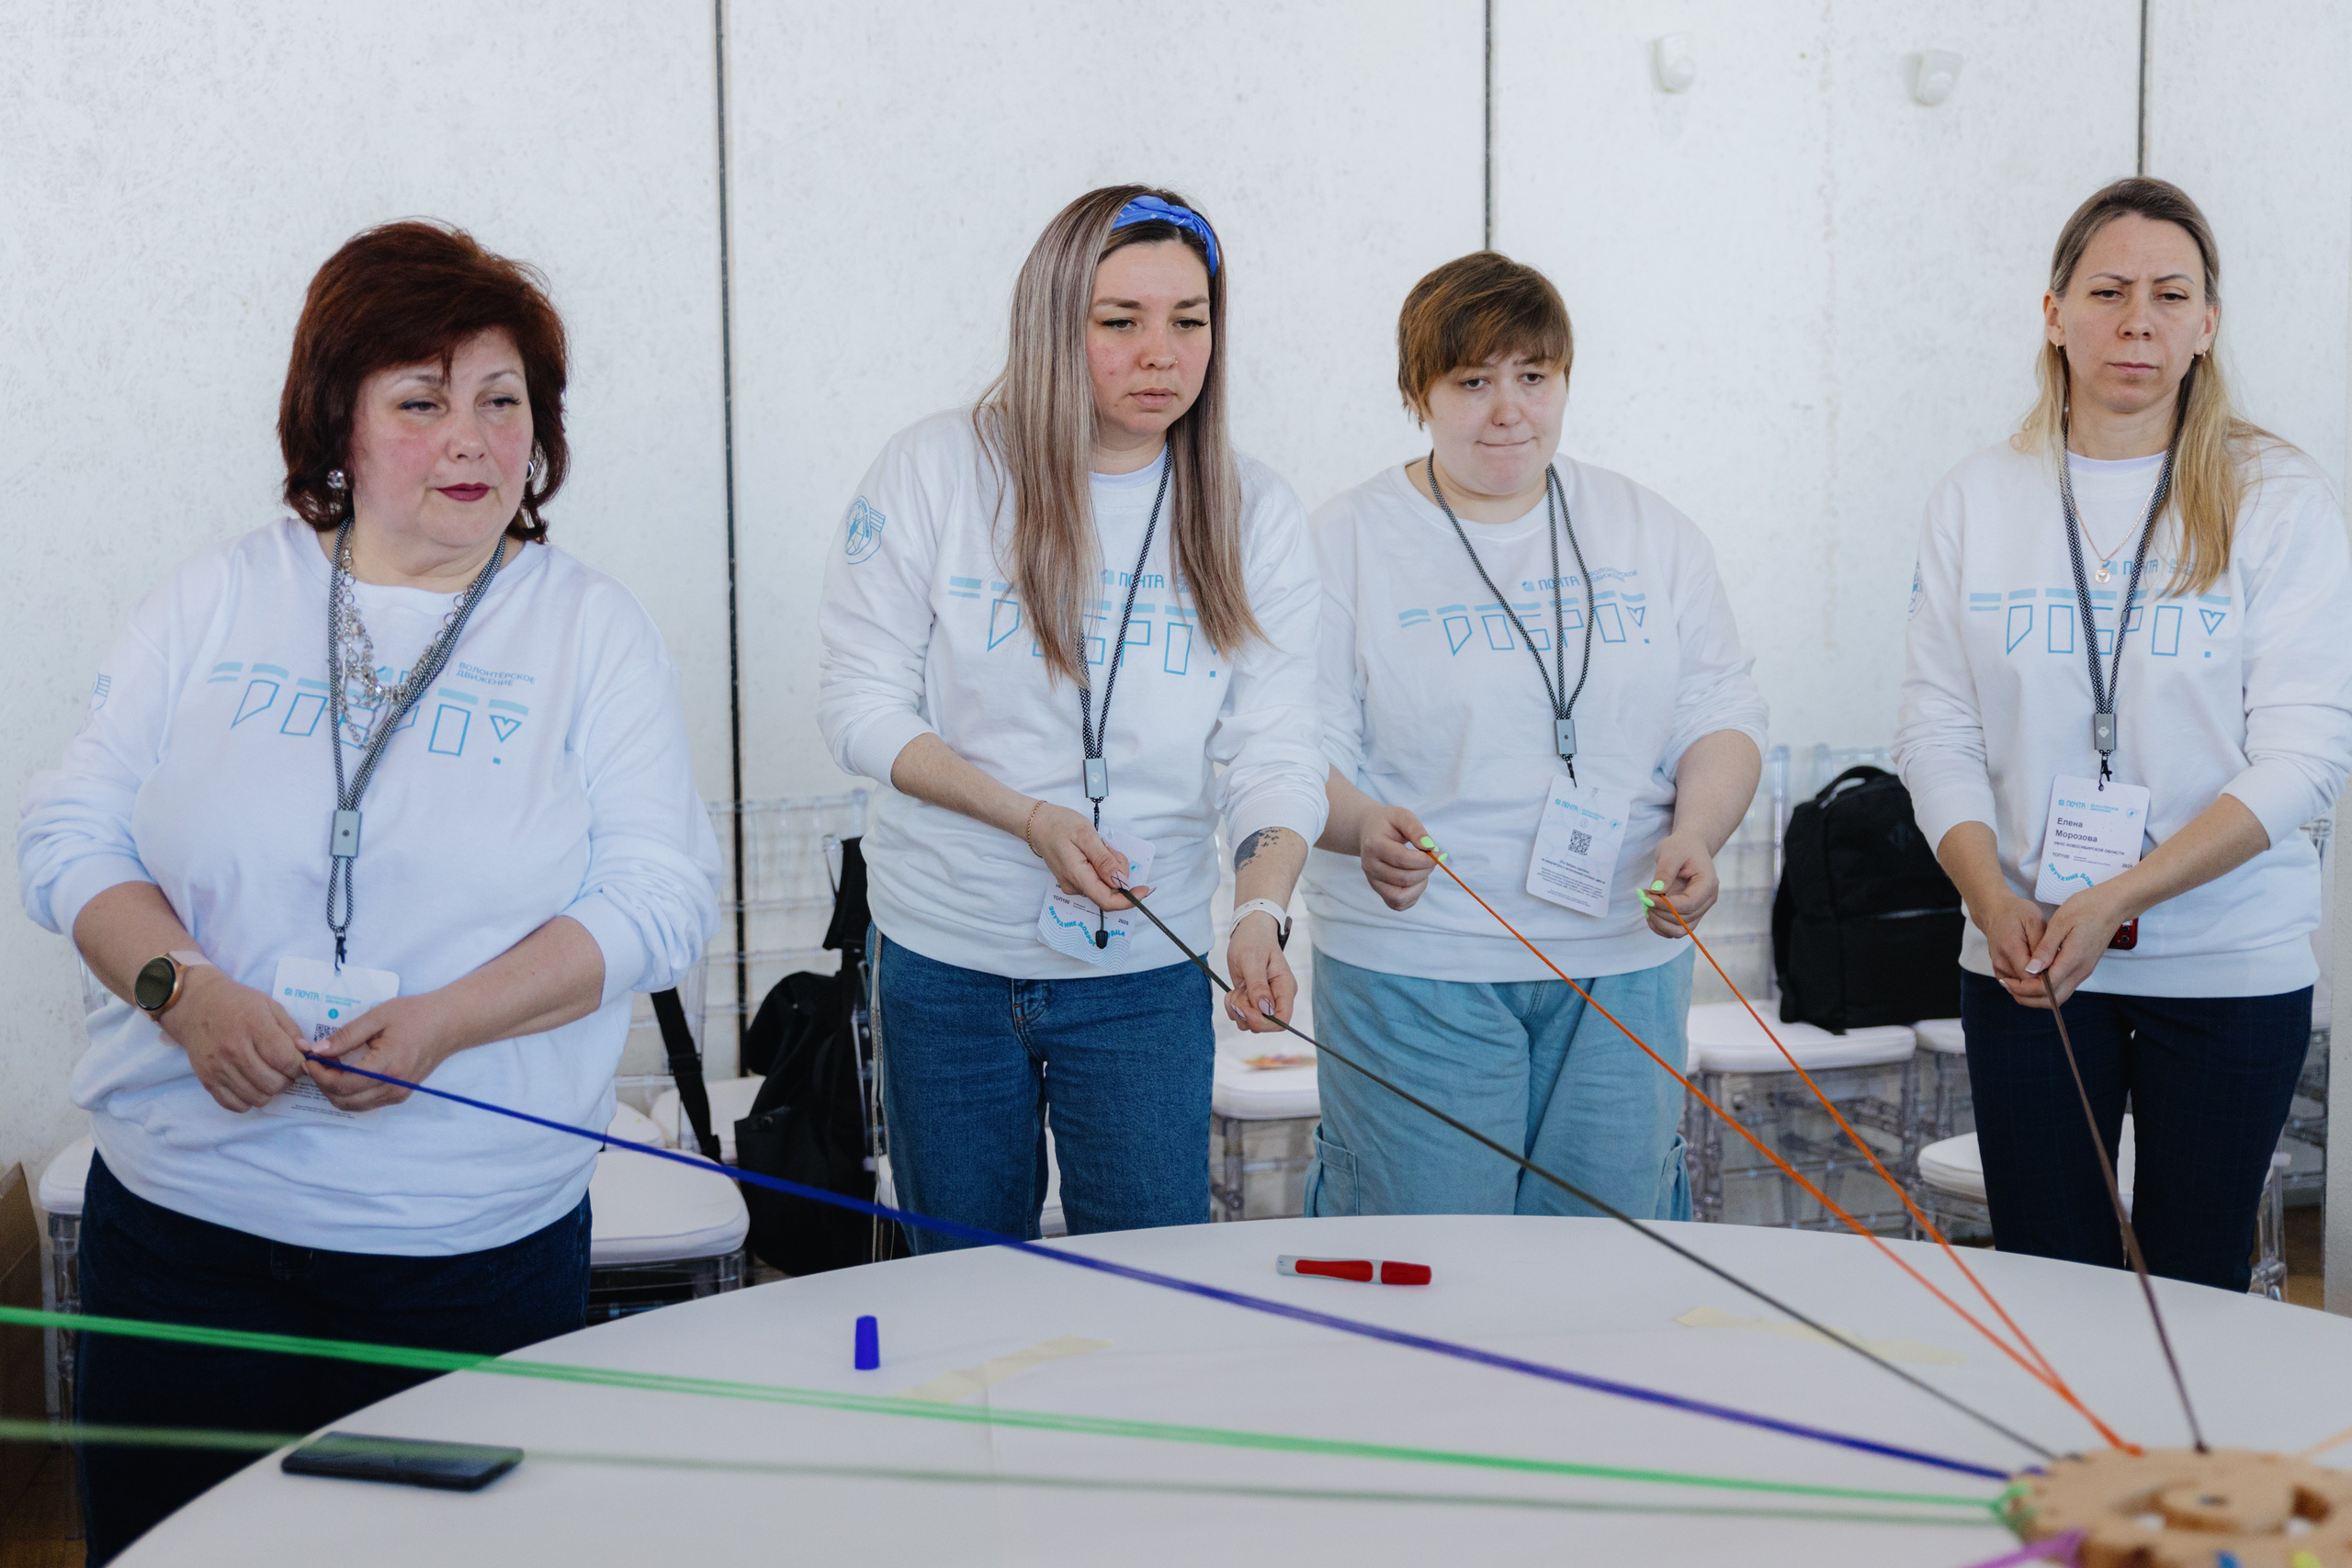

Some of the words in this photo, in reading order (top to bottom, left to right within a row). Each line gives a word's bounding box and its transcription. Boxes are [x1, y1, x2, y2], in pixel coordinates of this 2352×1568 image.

[456, 669, 514, 686] ДВИЖЕНИЕ
[2065, 800, 2086, 809] ПОЧТА
[2057, 817, 2084, 829] Елена
[2055, 829, 2098, 842] Морозова
[2066, 842, 2104, 852] НОВОСИБИРСКОЙ
[2104, 848, 2125, 856] ОБЛАСТИ
[2048, 863, 2078, 882] ЗВУЧАНИЕ
[1053, 895, 1070, 905] ТОП100
[1118, 918, 1129, 926] 2025
[1048, 906, 1077, 928] ЗВУЧАНИЕ
[1078, 921, 1096, 947] ДОБРОГ
[294, 988, 320, 1001] ПОЧТА
